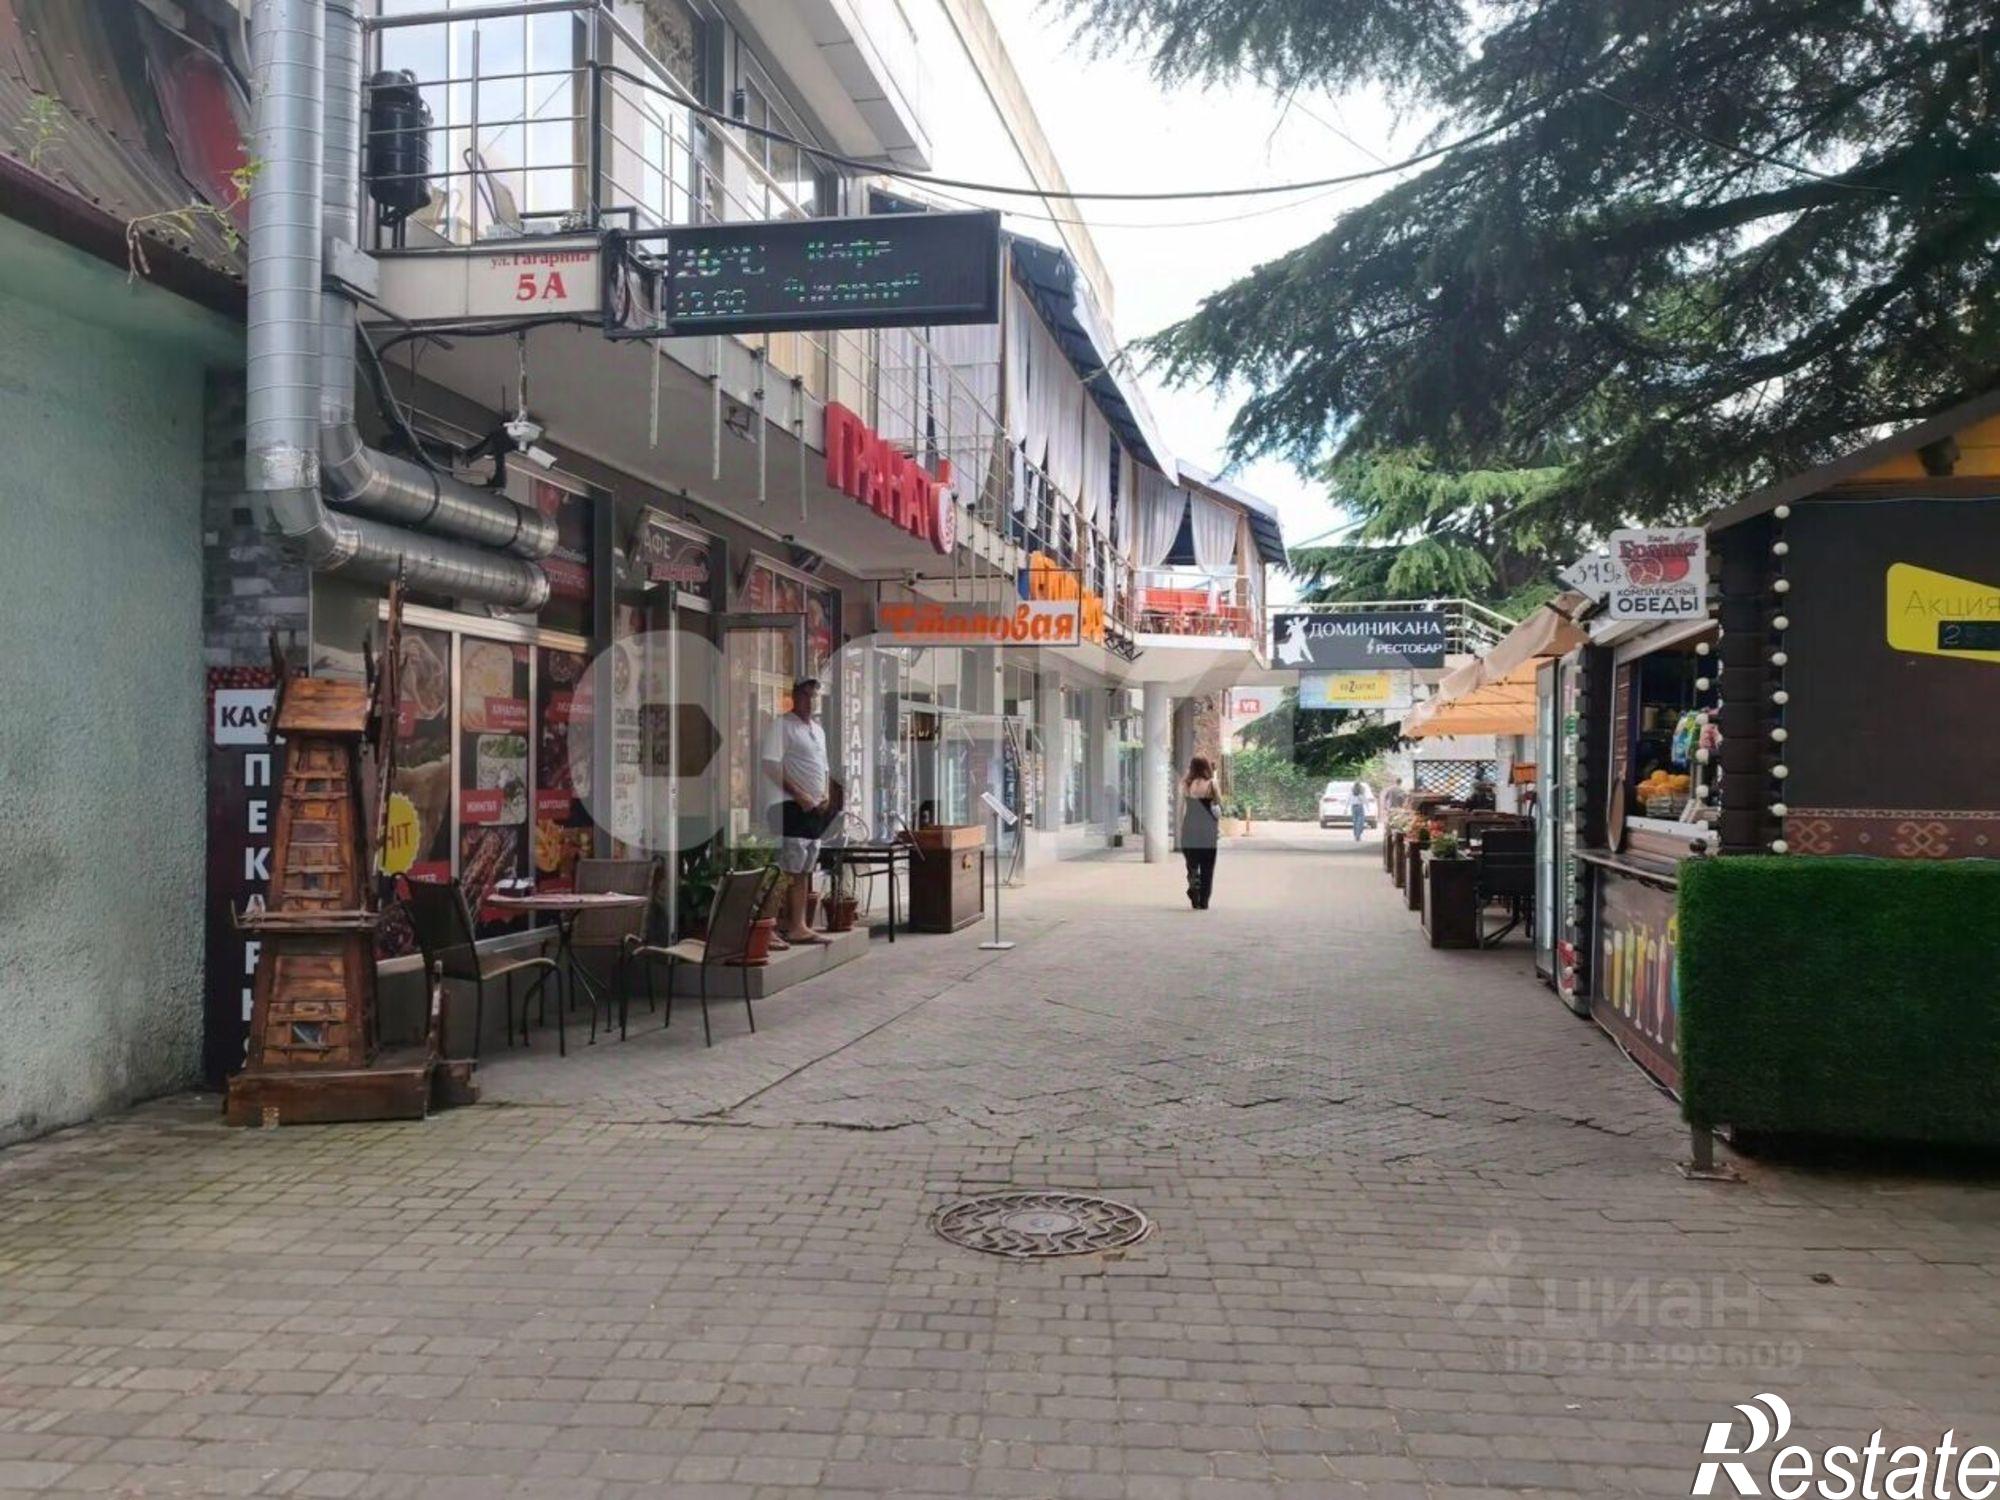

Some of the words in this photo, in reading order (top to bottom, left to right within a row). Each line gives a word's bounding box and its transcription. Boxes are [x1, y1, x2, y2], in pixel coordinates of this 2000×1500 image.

[516, 271, 567, 301] 5А
[1616, 585, 1698, 597] КОМПЛЕКСНЫЕ
[1617, 596, 1699, 615] ОБЕДЫ
[1904, 589, 2000, 618] Акция
[880, 603, 1073, 642] Столовая
[1308, 620, 1441, 639] ДОМИНИКАНА
[1375, 643, 1442, 654] РЕСТОБАР
[221, 705, 273, 728] КАФ
